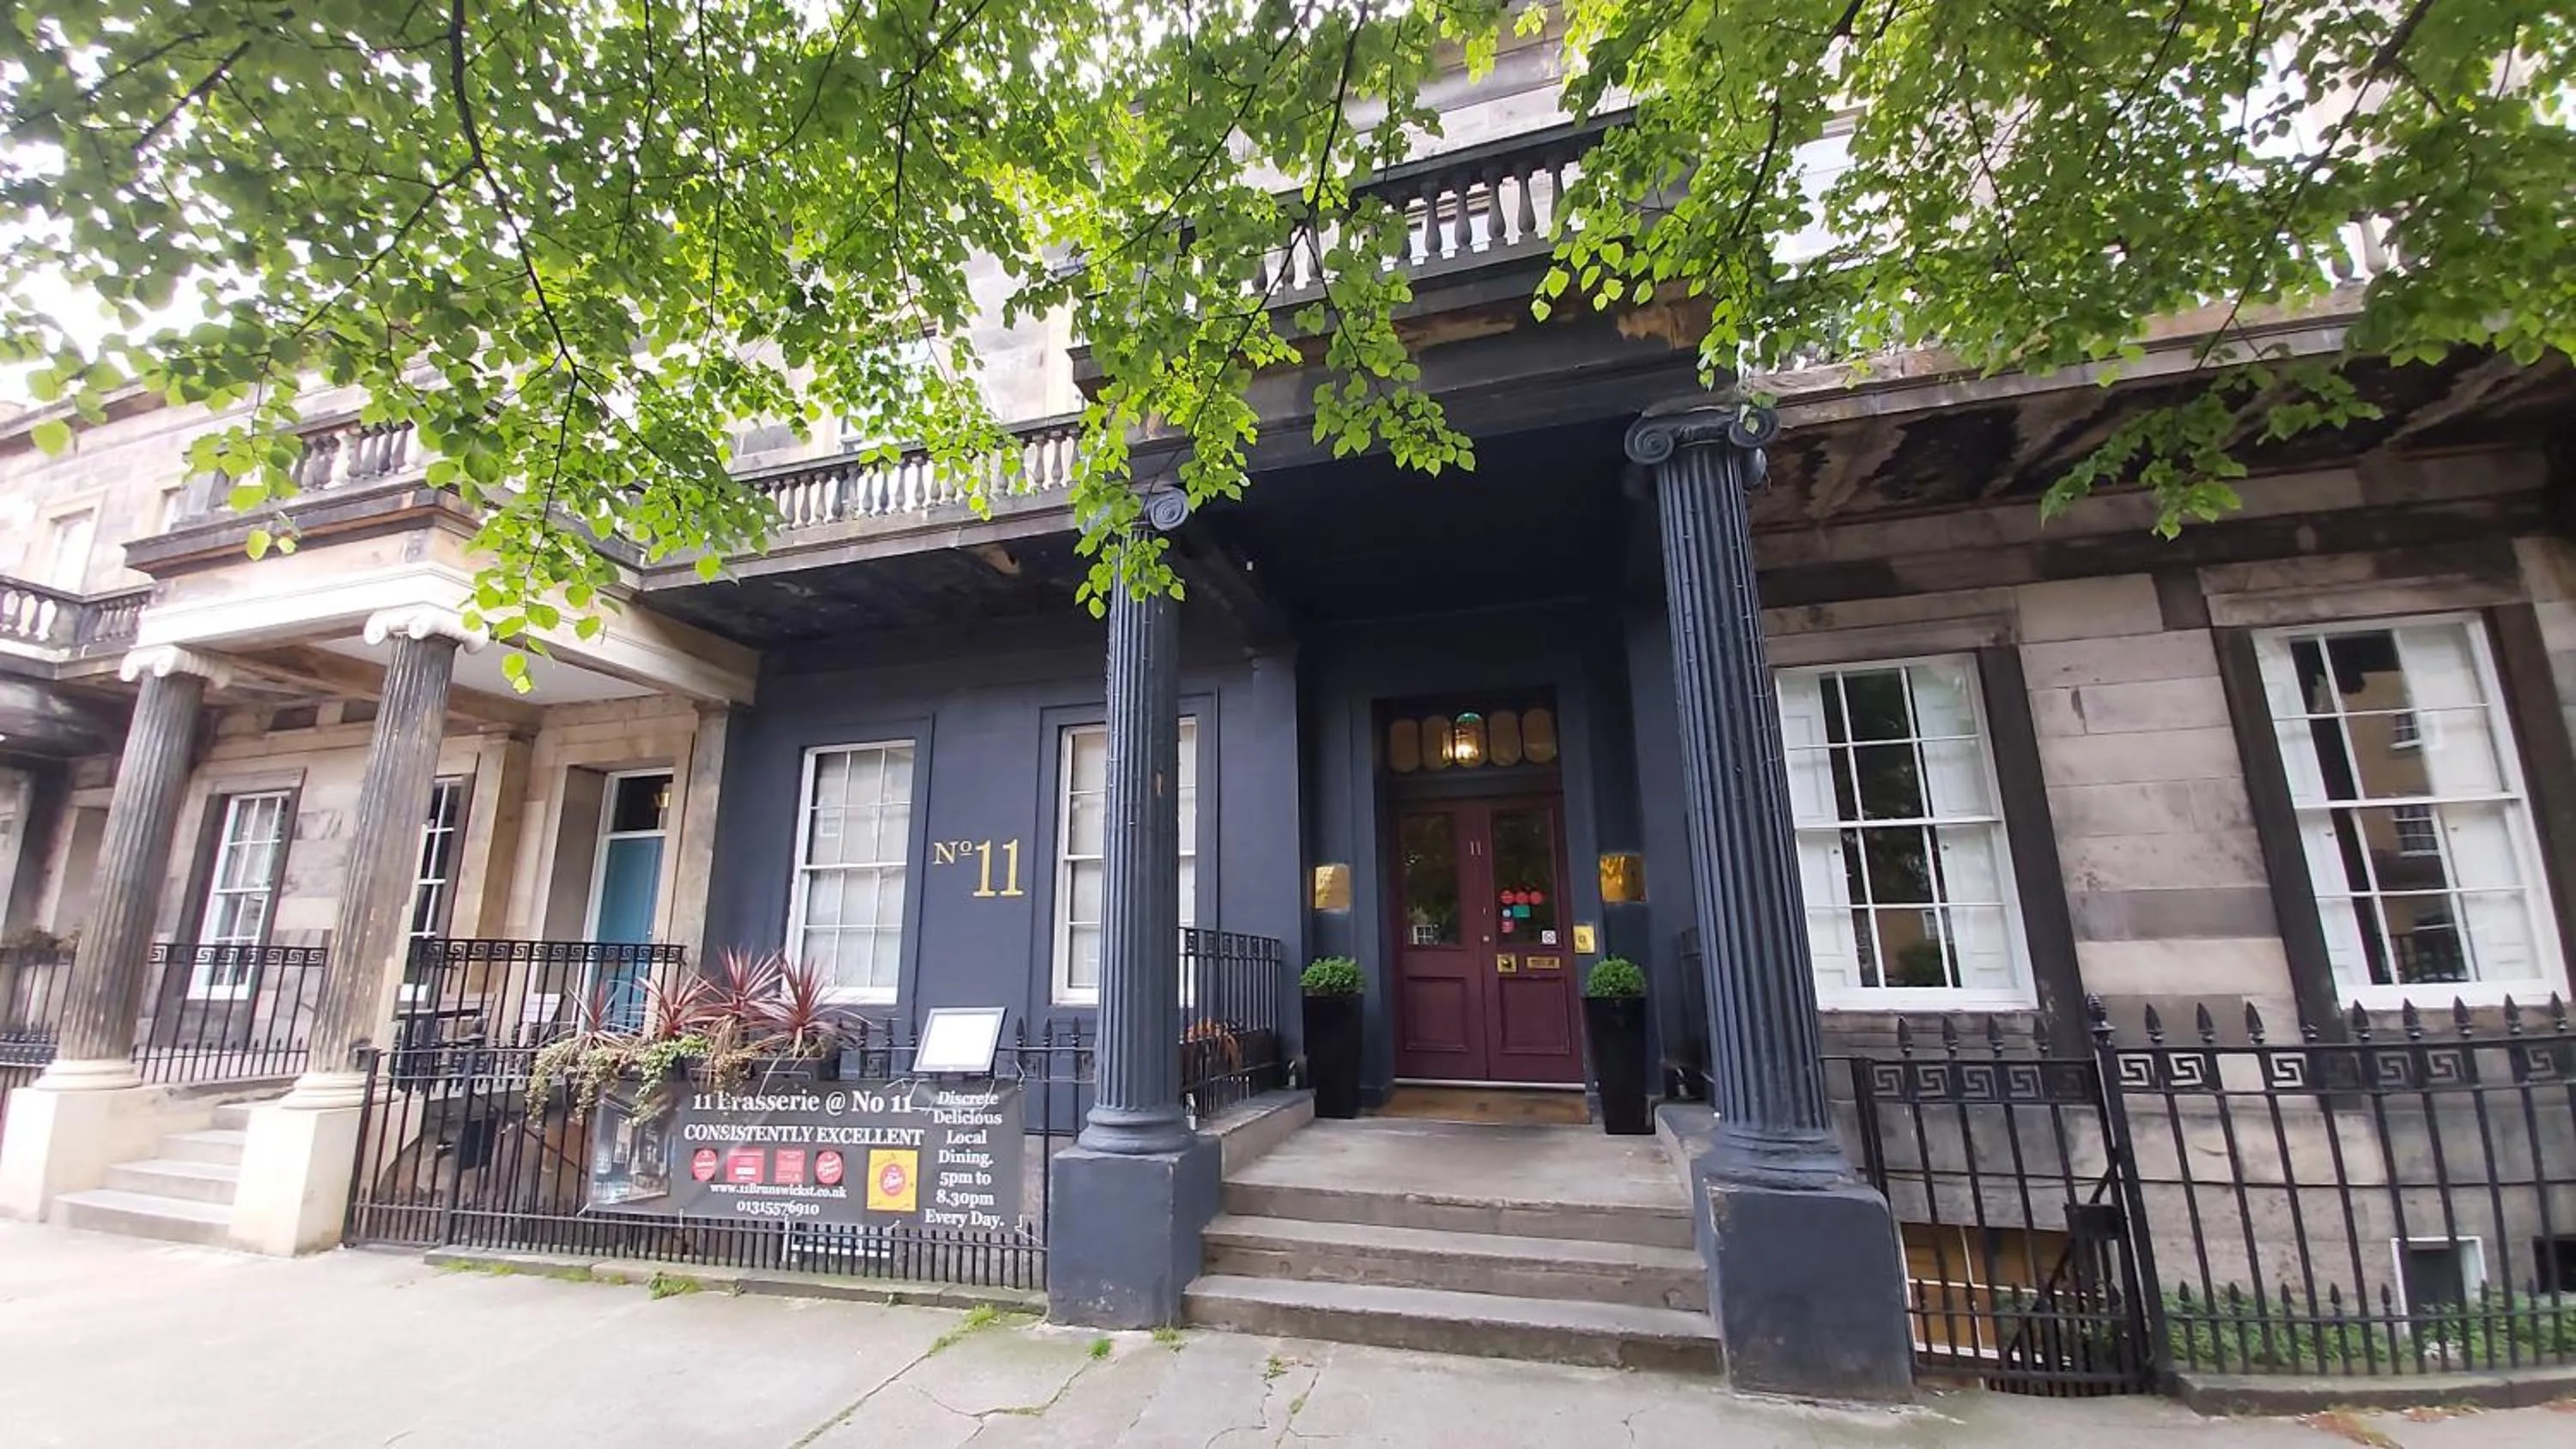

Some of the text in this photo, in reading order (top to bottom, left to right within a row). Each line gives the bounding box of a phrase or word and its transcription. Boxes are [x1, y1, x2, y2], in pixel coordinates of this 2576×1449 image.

[692, 1093, 713, 1110] 11
[825, 1091, 846, 1116] @
[851, 1090, 885, 1113] No
[890, 1094, 912, 1113] 11
[937, 1090, 999, 1105] Discrete
[933, 1108, 1003, 1125] Delicious
[683, 1124, 925, 1146] CONSISTENTLY EXCELLENT
[946, 1129, 987, 1144] Local
[938, 1149, 993, 1168] Dining.
[939, 1171, 992, 1187] 5pm to
[936, 1188, 995, 1209] 8.30pm
[736, 1200, 820, 1216] 01315576910
[925, 1208, 1005, 1230] Every Day.
